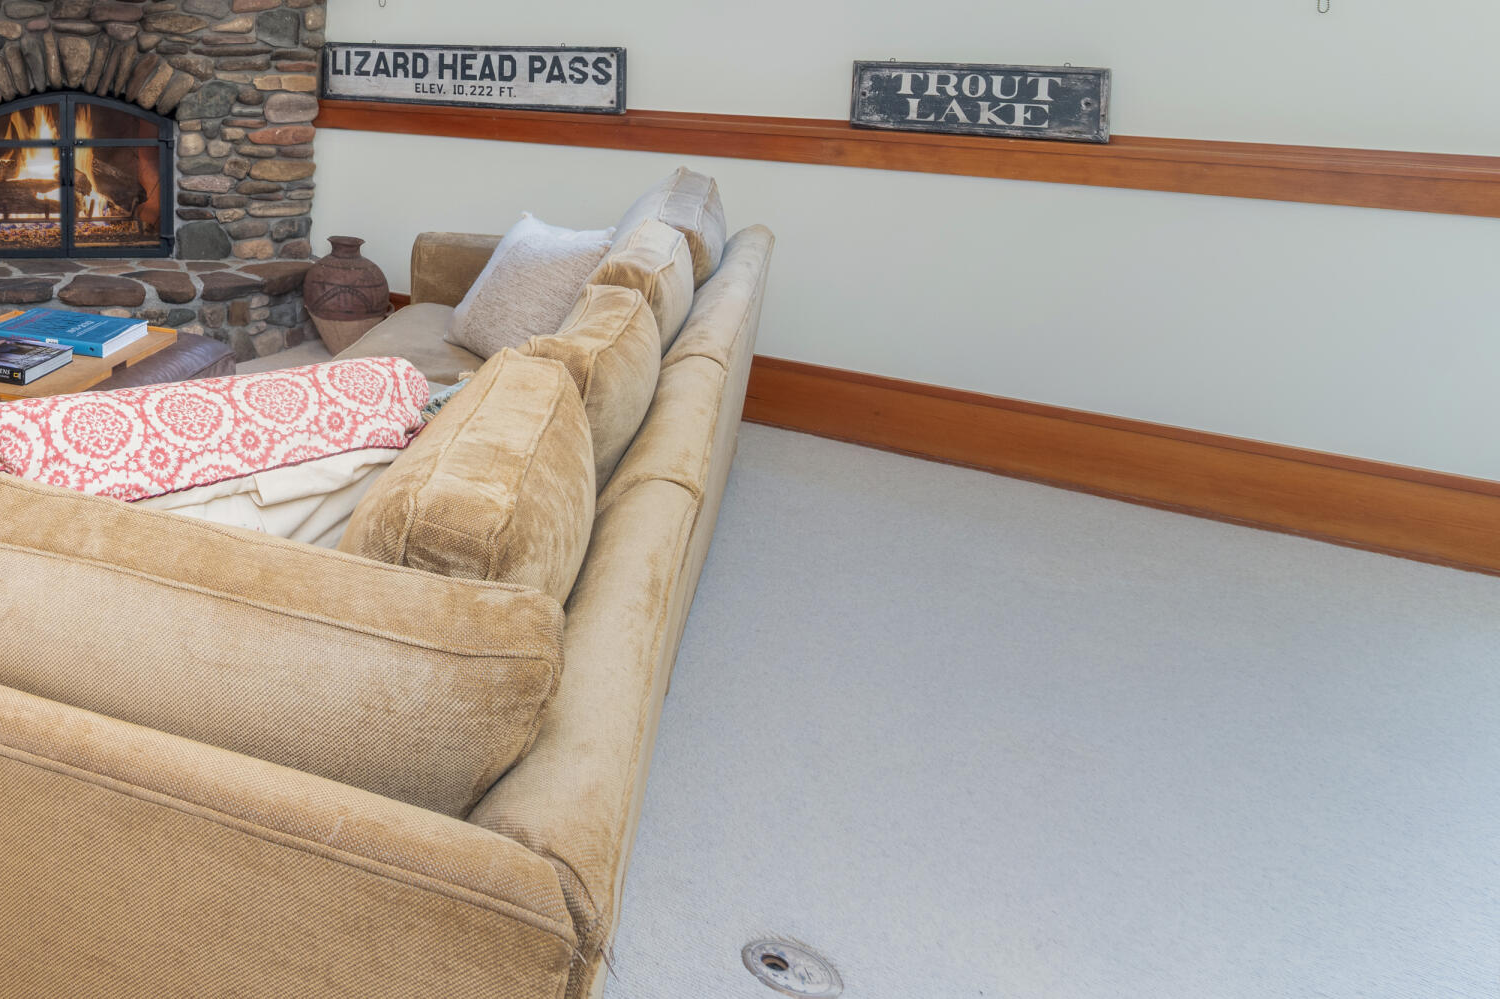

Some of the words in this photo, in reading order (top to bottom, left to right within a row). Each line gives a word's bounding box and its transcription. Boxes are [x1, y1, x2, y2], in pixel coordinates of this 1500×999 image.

[331, 50, 430, 80] LIZARD
[438, 52, 517, 82] HEAD
[528, 55, 613, 86] PASS
[414, 84, 446, 95] ELEV.
[453, 84, 494, 97] 10,222
[499, 86, 517, 98] FT.
[891, 71, 1062, 102] TROUT
[905, 97, 1049, 129] LAKE
